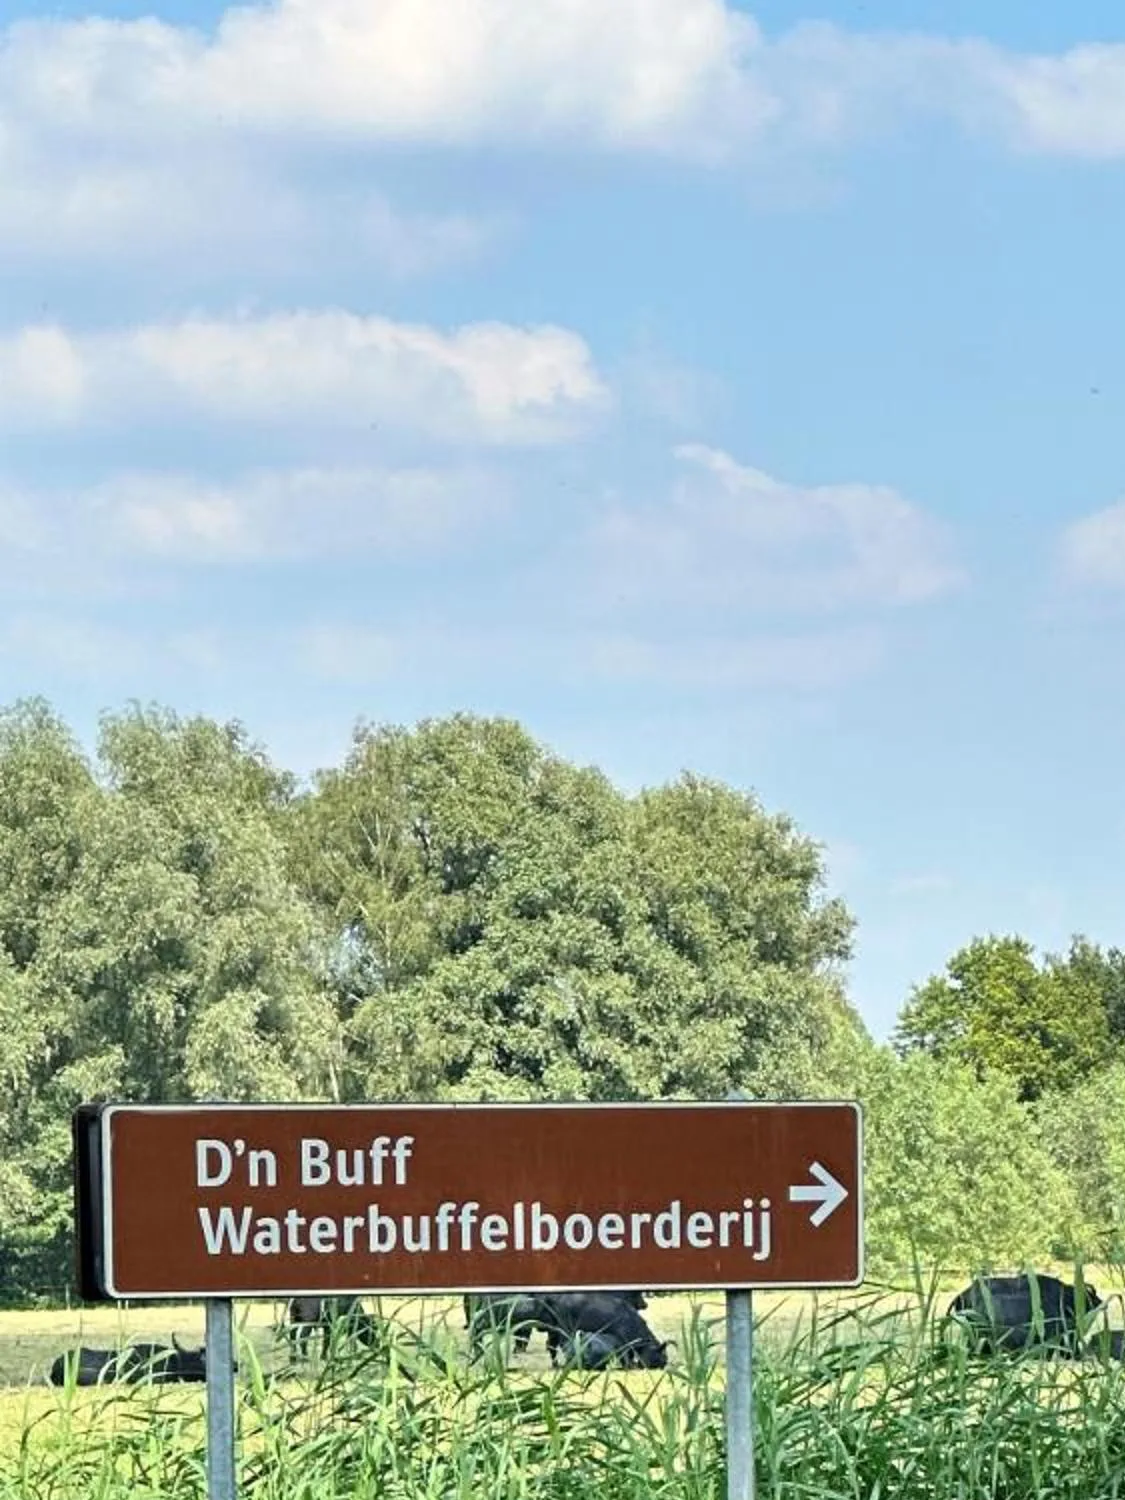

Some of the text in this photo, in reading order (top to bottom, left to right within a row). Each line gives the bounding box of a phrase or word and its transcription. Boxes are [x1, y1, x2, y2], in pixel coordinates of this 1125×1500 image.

[195, 1135, 415, 1188] D'n Buff
[197, 1198, 772, 1261] Waterbuffelboerderij
